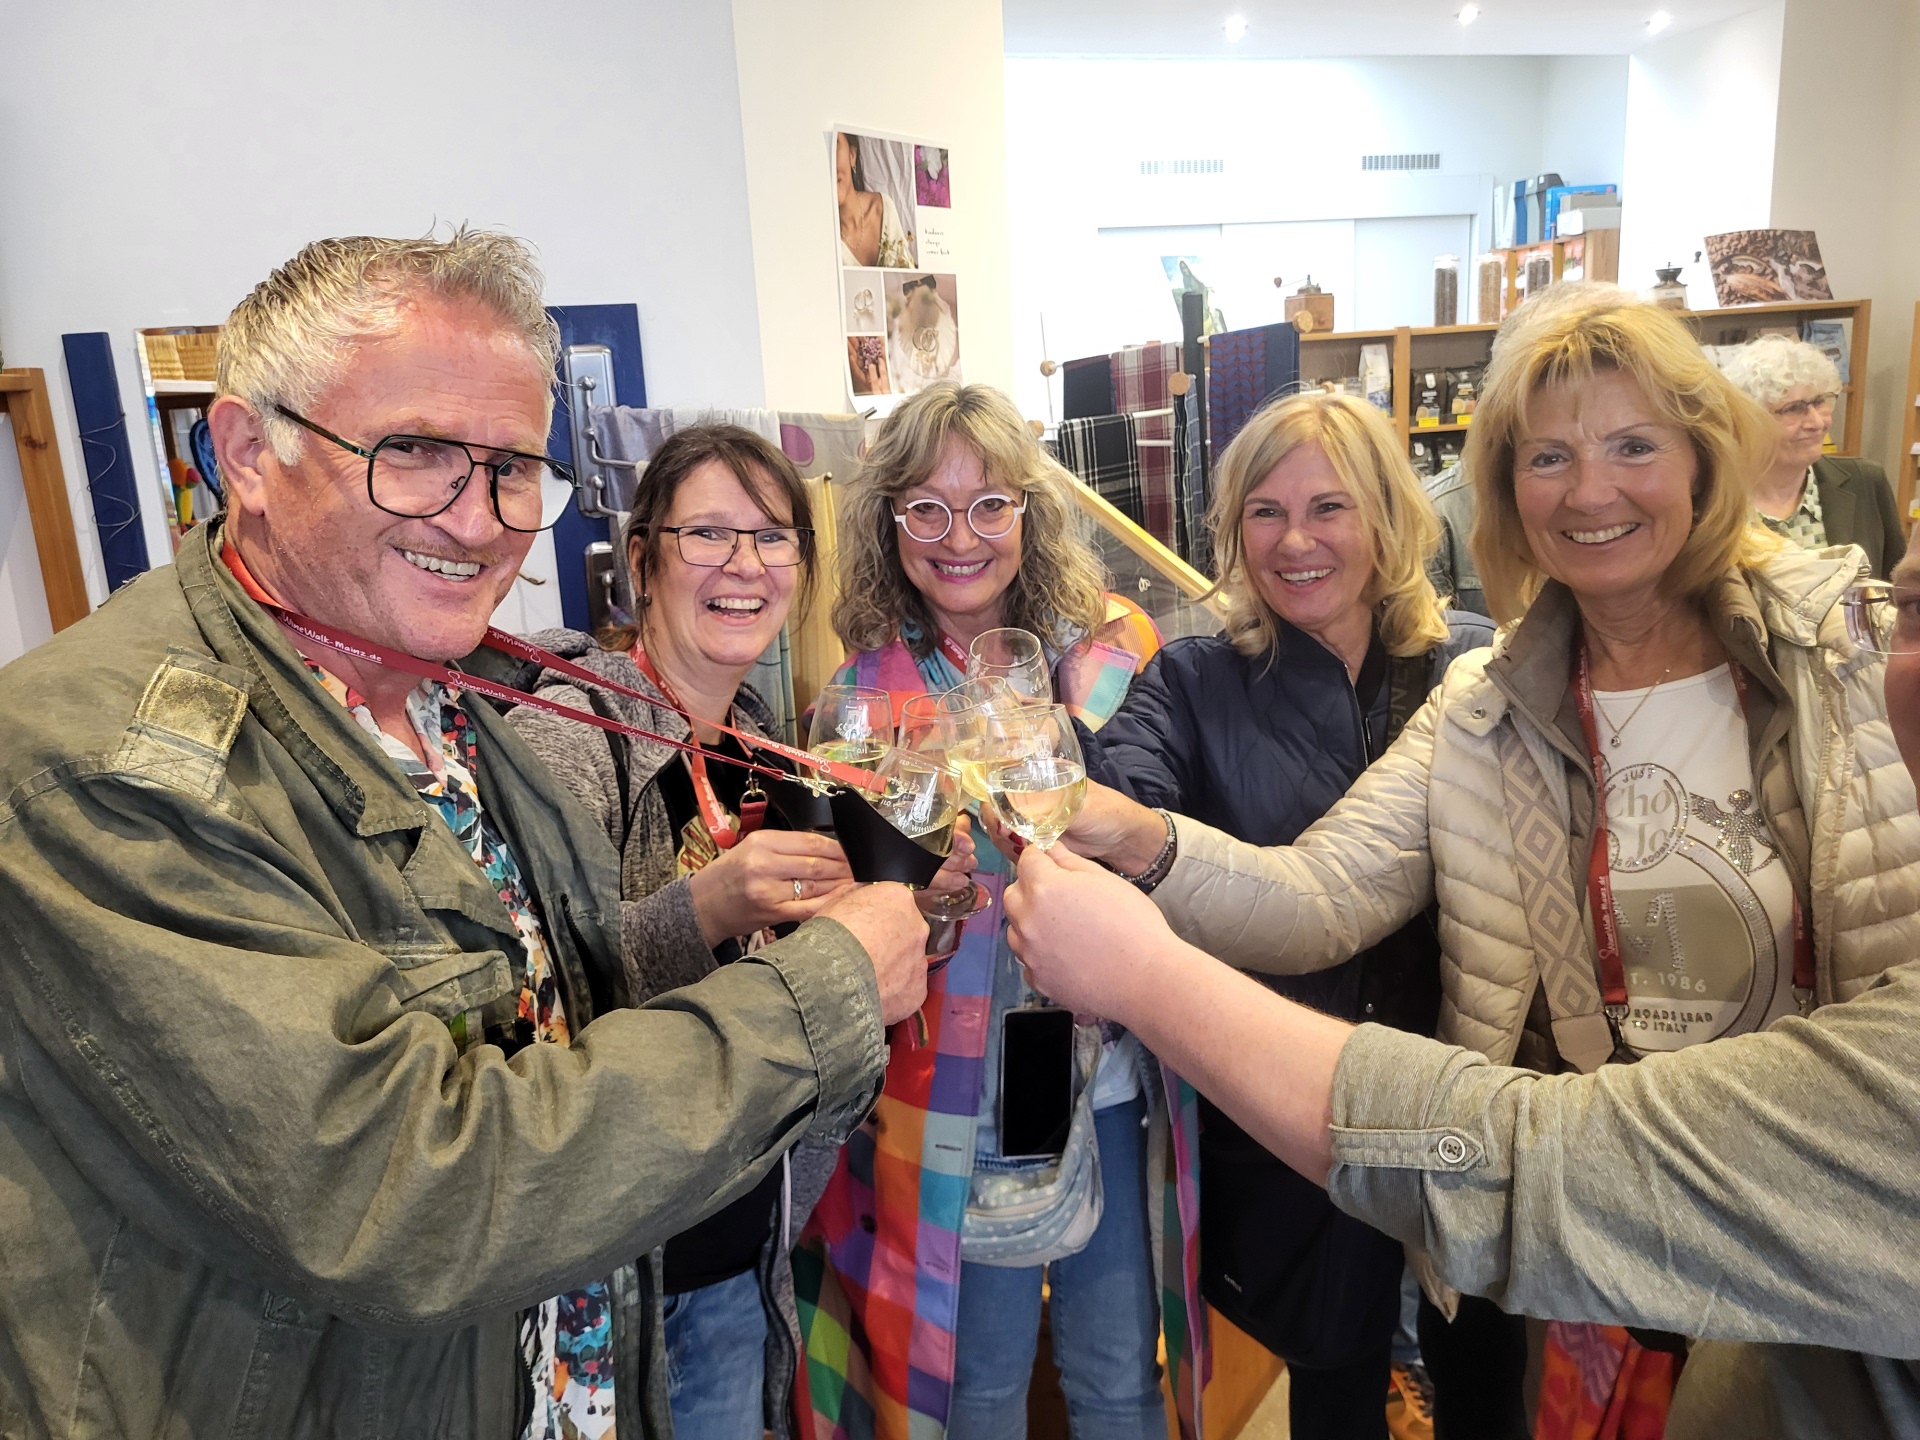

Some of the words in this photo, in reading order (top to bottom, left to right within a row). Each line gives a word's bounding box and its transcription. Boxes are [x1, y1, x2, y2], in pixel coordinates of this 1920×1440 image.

[282, 611, 382, 661] WineWalk-Mainz.de
[458, 679, 558, 714] WineWalk-Mainz.de
[1622, 767, 1656, 783] JUST
[1657, 972, 1707, 993] 1986
[1634, 1008, 1677, 1022] ROADS
[1680, 1011, 1713, 1023] LEAD
[1631, 1019, 1649, 1030] TO
[1653, 1022, 1688, 1034] ITALY
